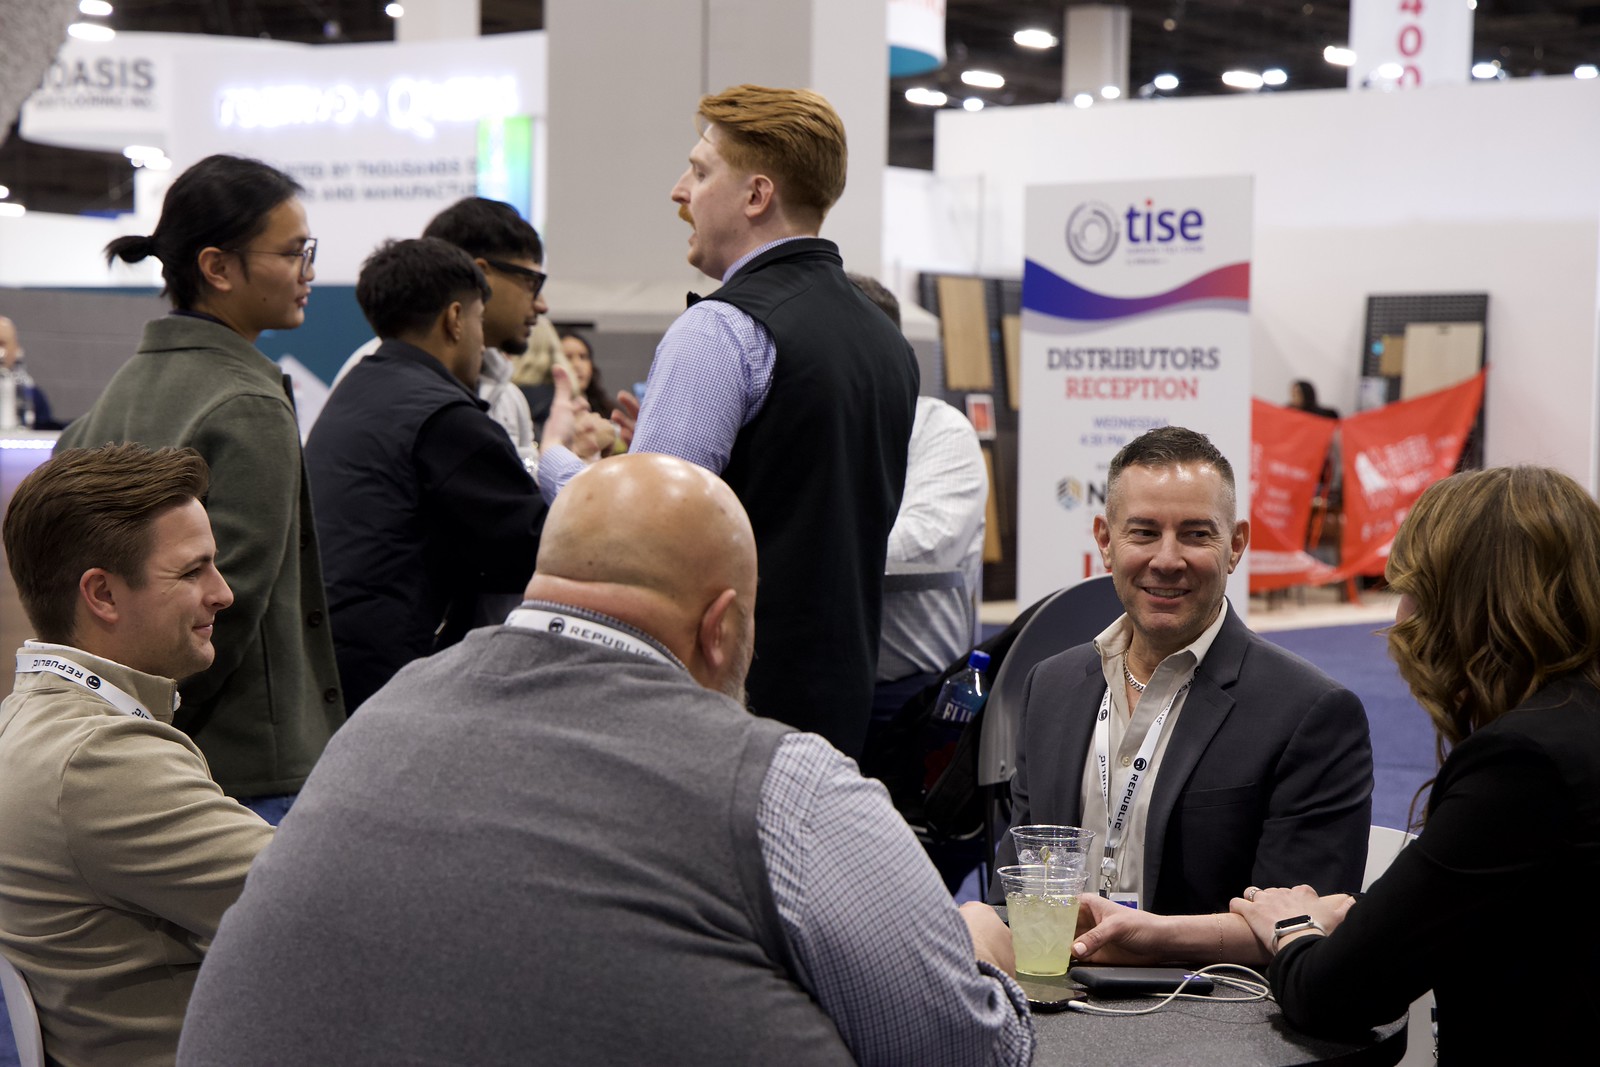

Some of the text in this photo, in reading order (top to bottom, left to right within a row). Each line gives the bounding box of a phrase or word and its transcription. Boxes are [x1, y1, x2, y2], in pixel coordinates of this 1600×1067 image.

[1125, 199, 1204, 243] tise
[1047, 347, 1220, 370] DISTRIBUTORS
[1065, 376, 1199, 400] RECEPTION
[31, 659, 85, 680] REPUBLIC
[1114, 773, 1138, 831] REPUBLIC
